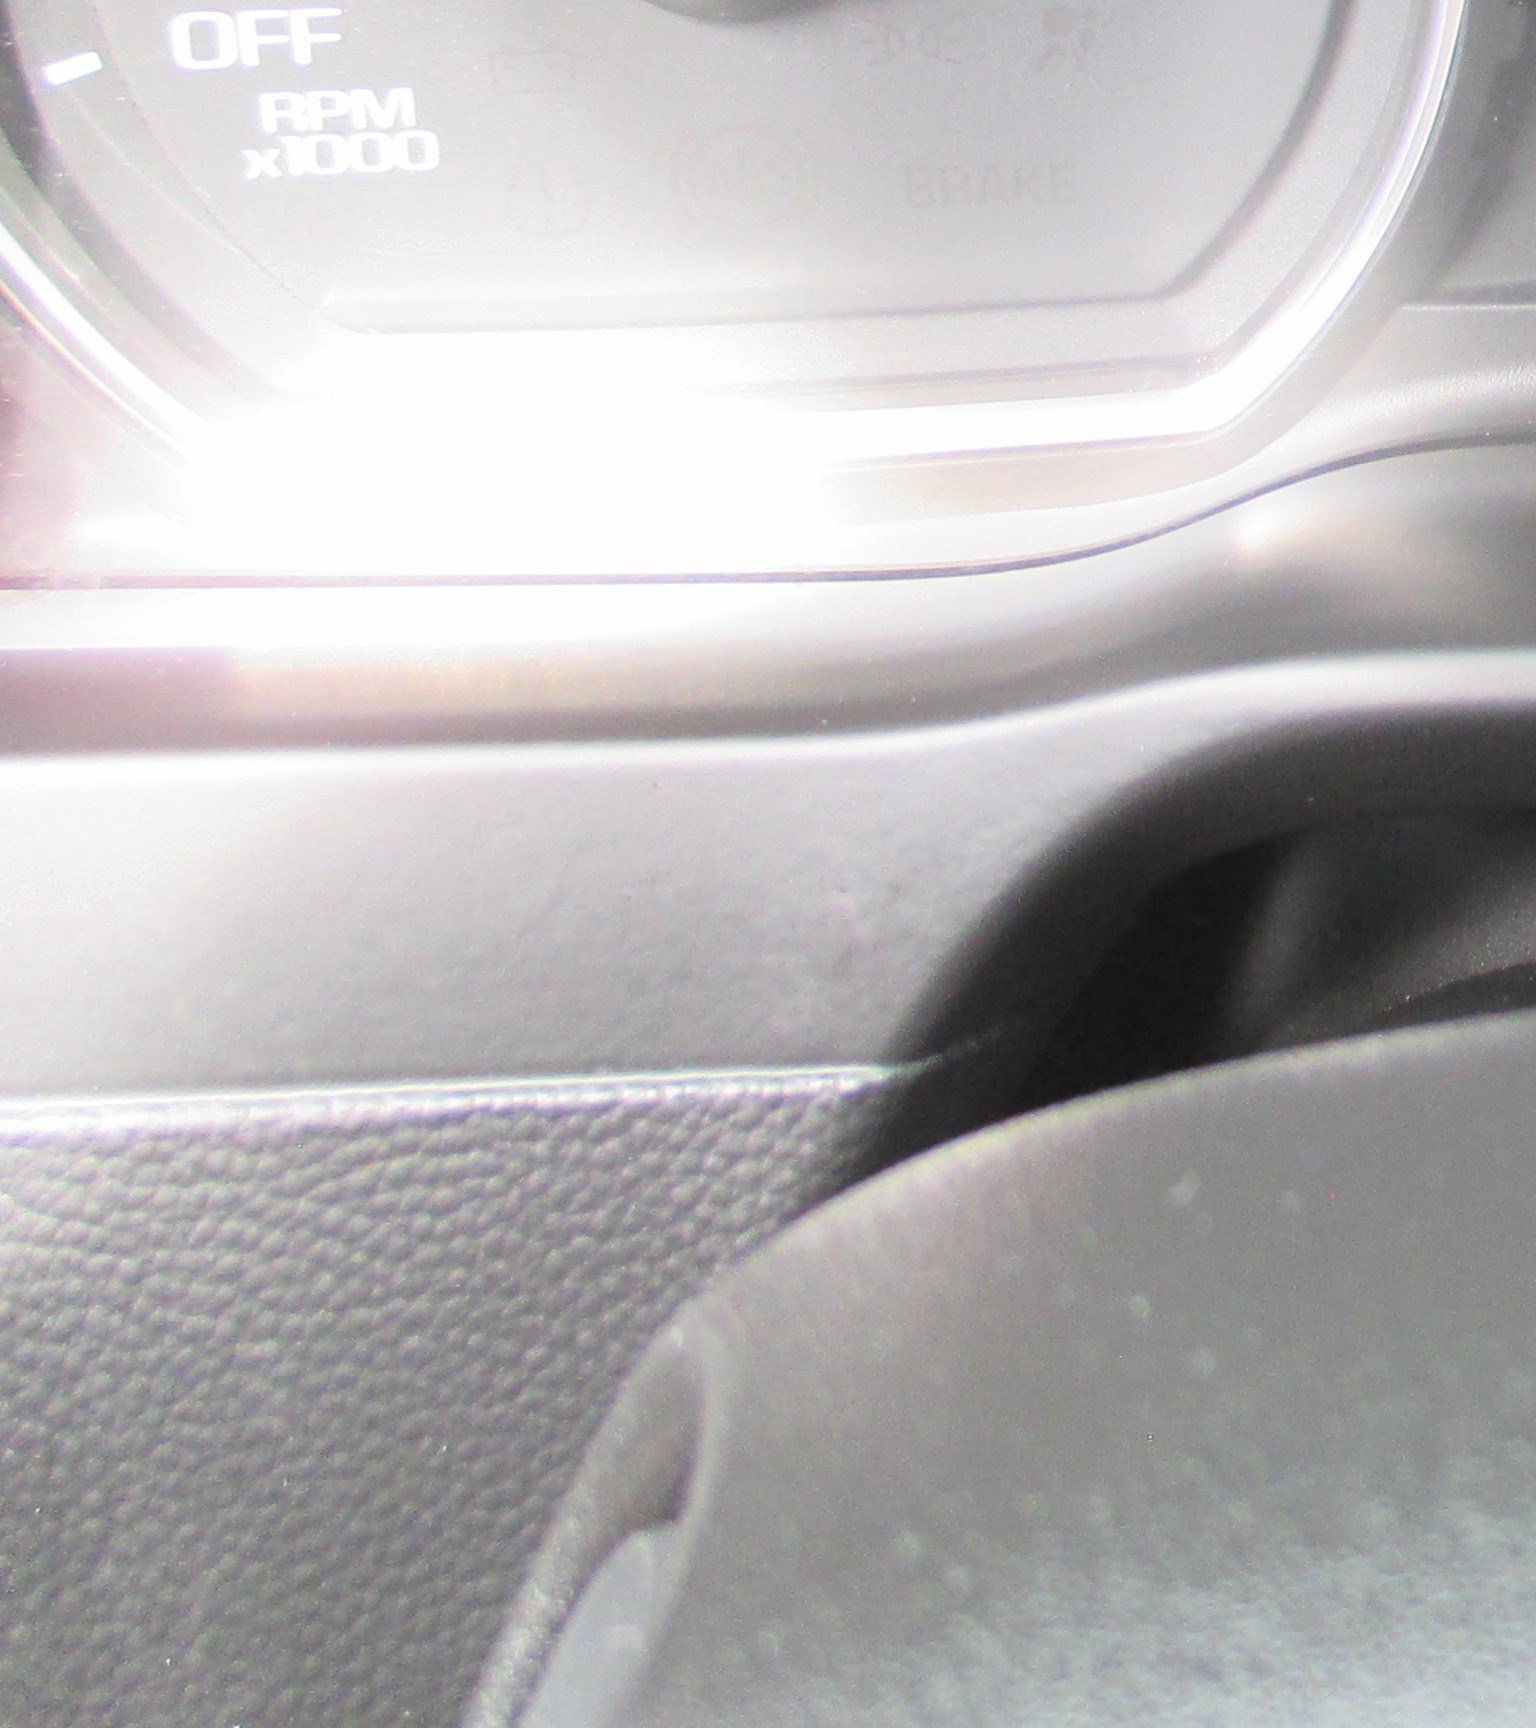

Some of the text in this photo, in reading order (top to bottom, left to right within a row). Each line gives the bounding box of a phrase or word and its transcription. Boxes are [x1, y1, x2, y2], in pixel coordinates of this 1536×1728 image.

[167, 6, 341, 74] OFF
[258, 86, 415, 130] RPM
[242, 132, 439, 180] x1000
